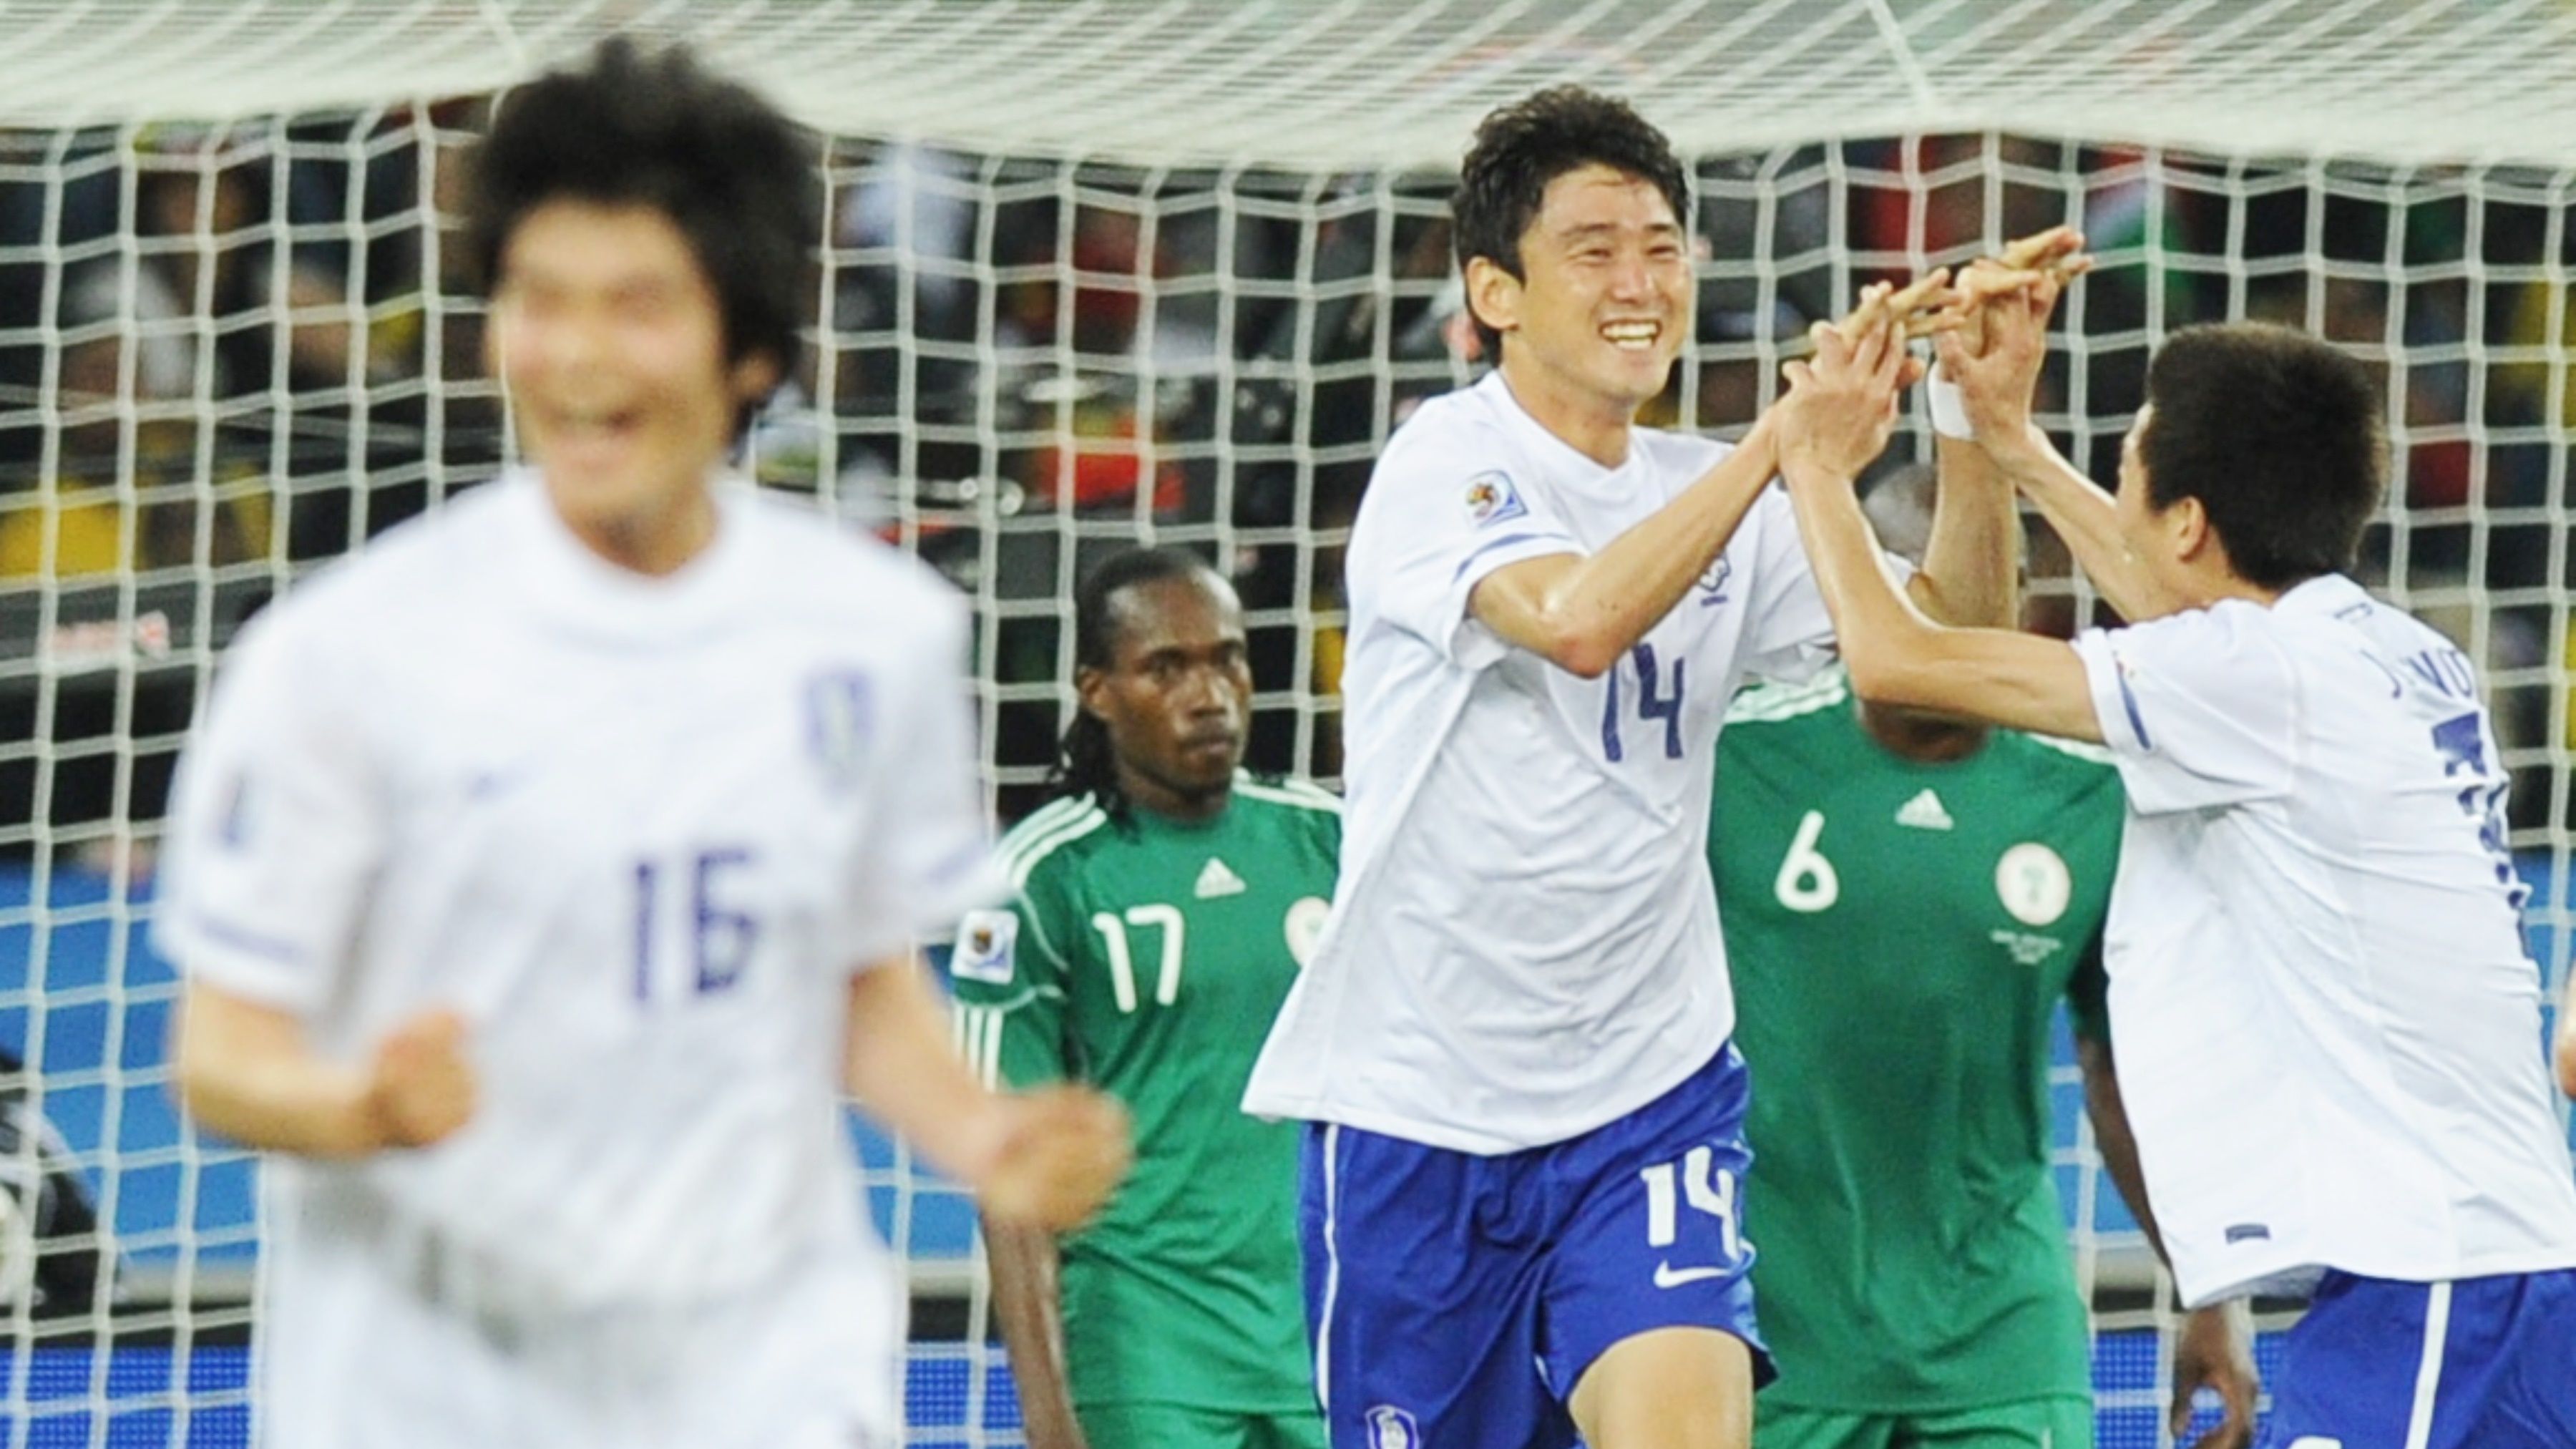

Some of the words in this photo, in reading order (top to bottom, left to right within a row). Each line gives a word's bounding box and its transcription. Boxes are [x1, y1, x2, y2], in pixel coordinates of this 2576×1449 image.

[1602, 642, 1684, 763] 14
[1773, 809, 1840, 913] 6
[631, 843, 761, 1003] 16
[1092, 903, 1184, 1014] 17
[1639, 1144, 1743, 1262] 14
